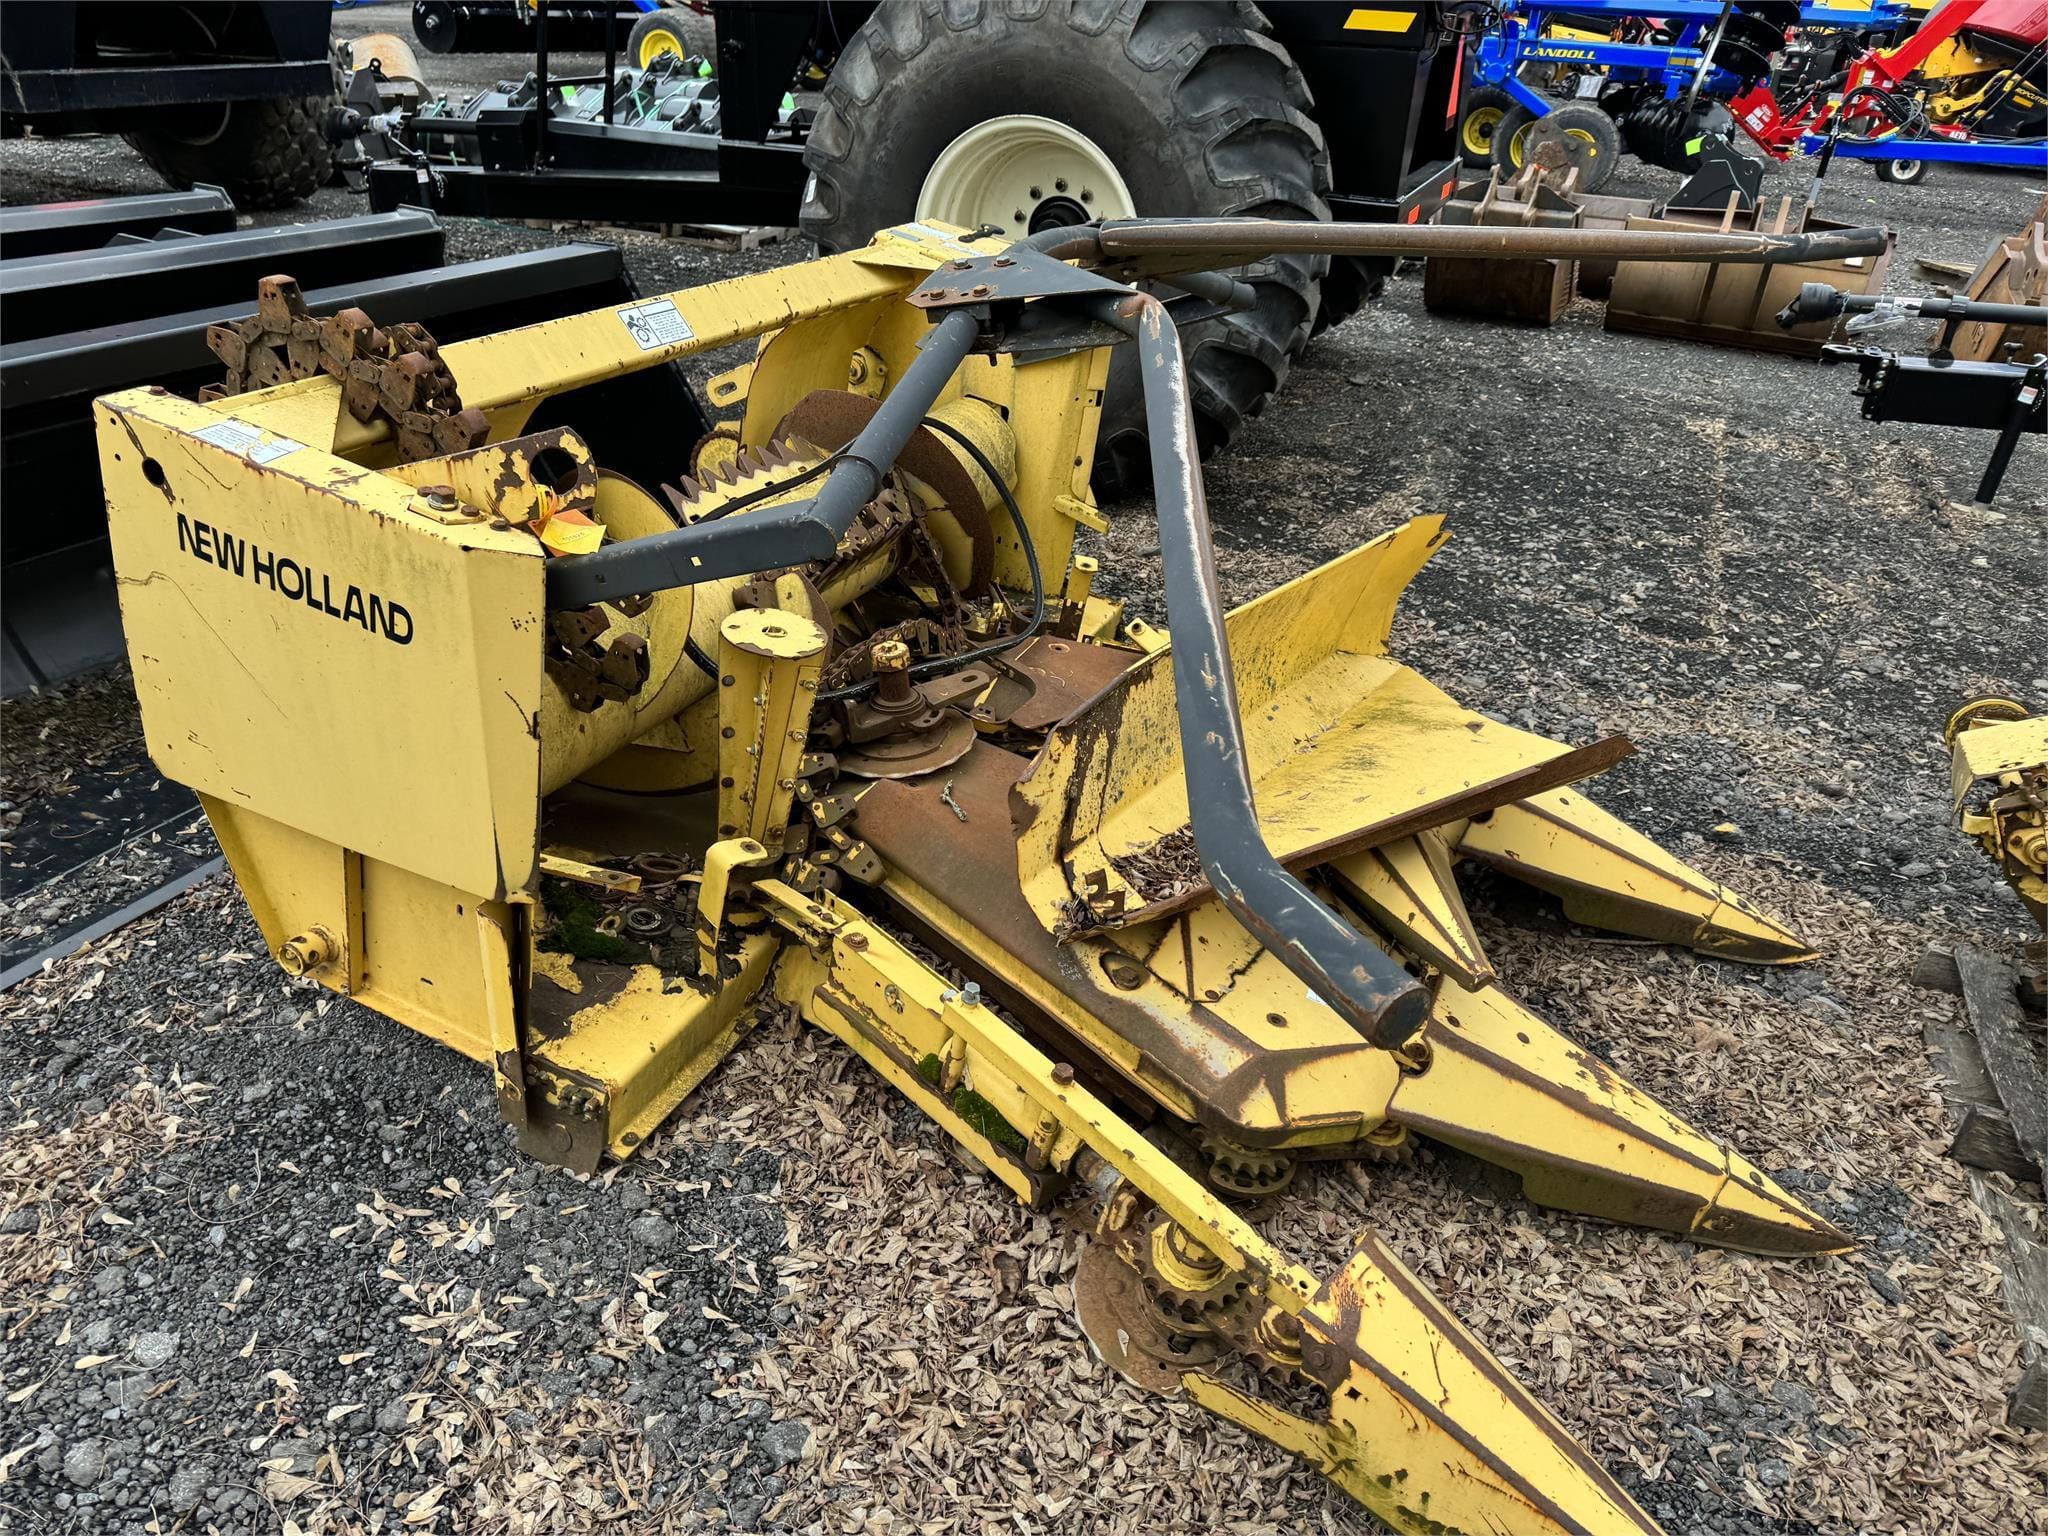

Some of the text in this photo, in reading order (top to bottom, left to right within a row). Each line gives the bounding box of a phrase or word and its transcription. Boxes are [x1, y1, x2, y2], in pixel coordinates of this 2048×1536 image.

[1522, 46, 1596, 60] LANDOLL
[177, 512, 414, 646] NEW HOLLAND
